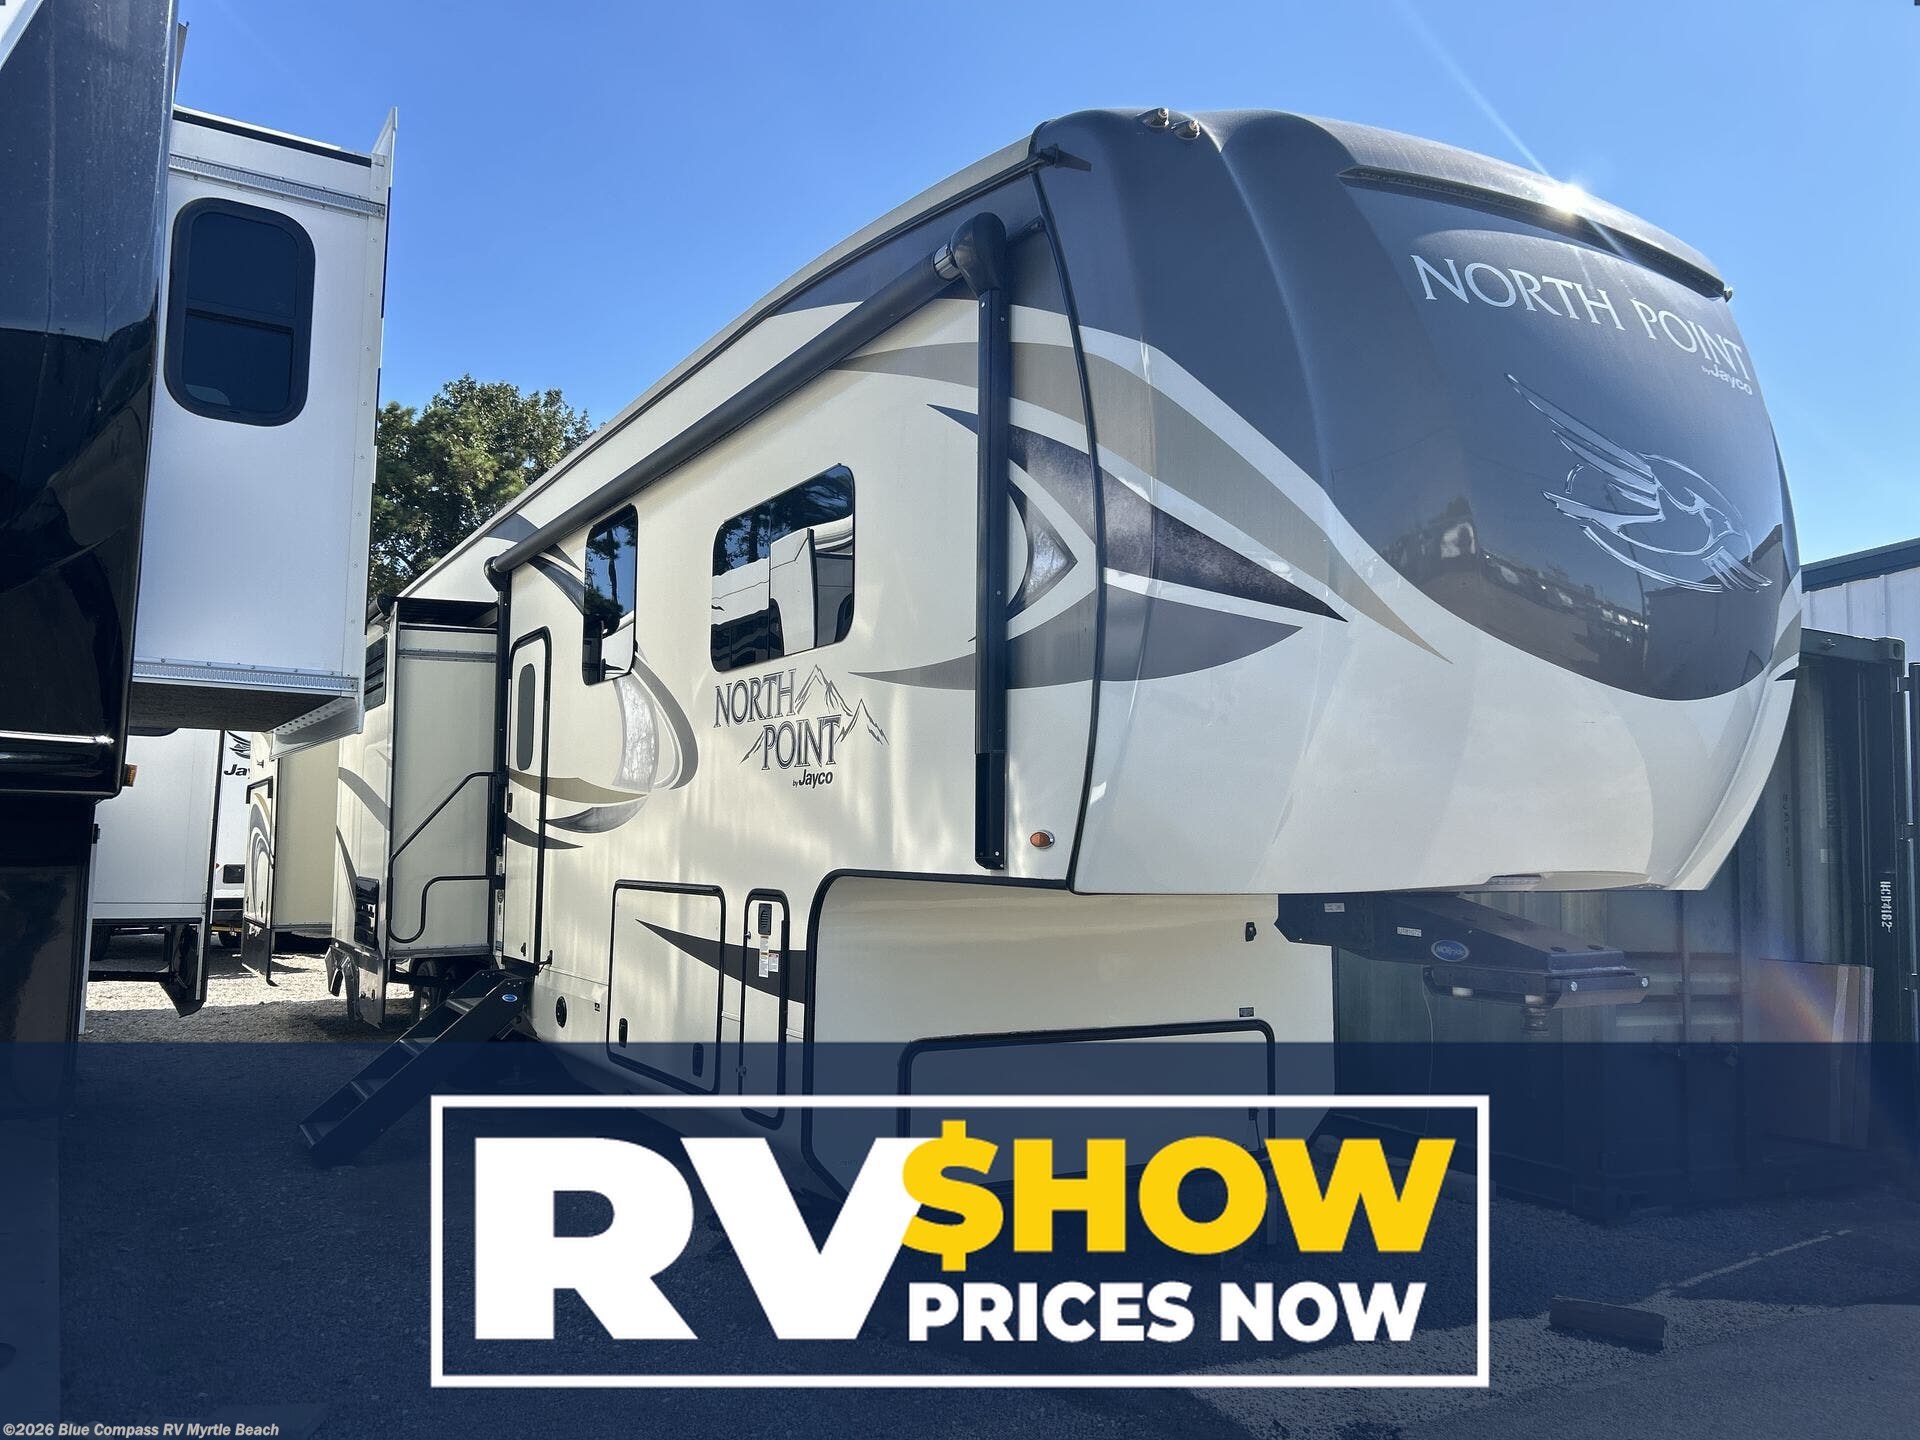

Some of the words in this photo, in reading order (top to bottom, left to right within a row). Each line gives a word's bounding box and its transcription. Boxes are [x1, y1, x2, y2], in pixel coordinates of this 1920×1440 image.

[1410, 254, 1626, 331] NORTH
[1630, 297, 1752, 382] POINT
[1709, 363, 1753, 396] Jayco
[713, 668, 797, 728] NORTH
[761, 714, 842, 771] POINT
[223, 763, 251, 780] Ja
[799, 768, 834, 789] Jayco
